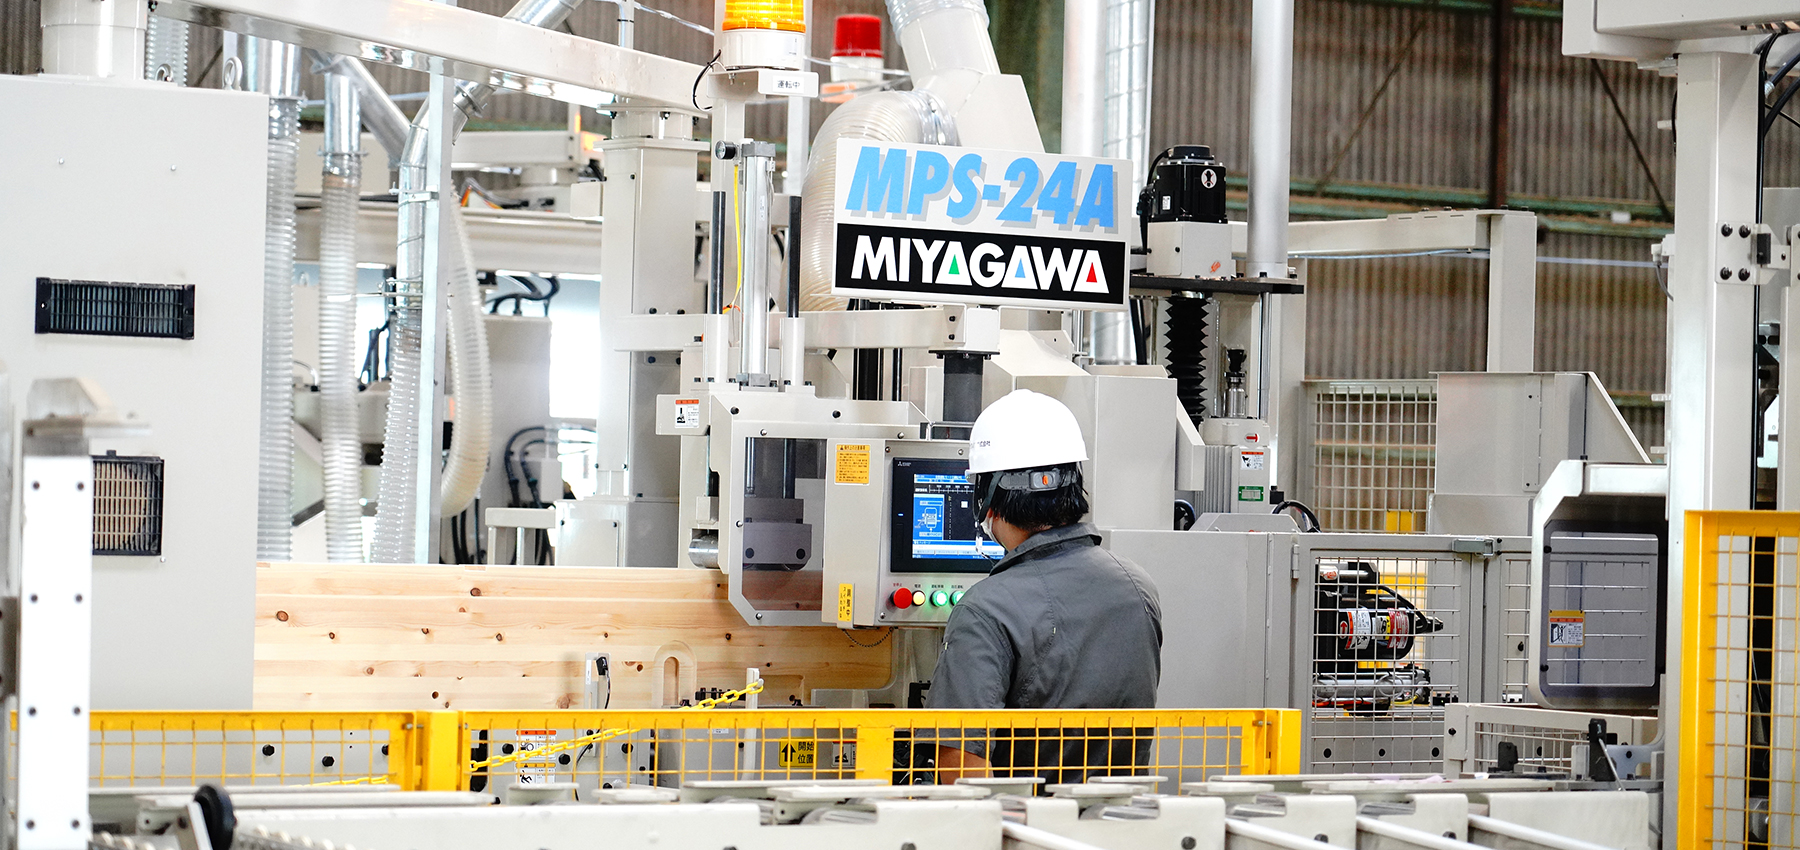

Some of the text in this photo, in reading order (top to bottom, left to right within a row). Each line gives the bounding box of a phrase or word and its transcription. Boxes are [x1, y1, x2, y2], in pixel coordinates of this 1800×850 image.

[845, 146, 1117, 232] MPS-24A
[851, 235, 1110, 294] MIYAGAWA
[798, 741, 814, 751] 開始
